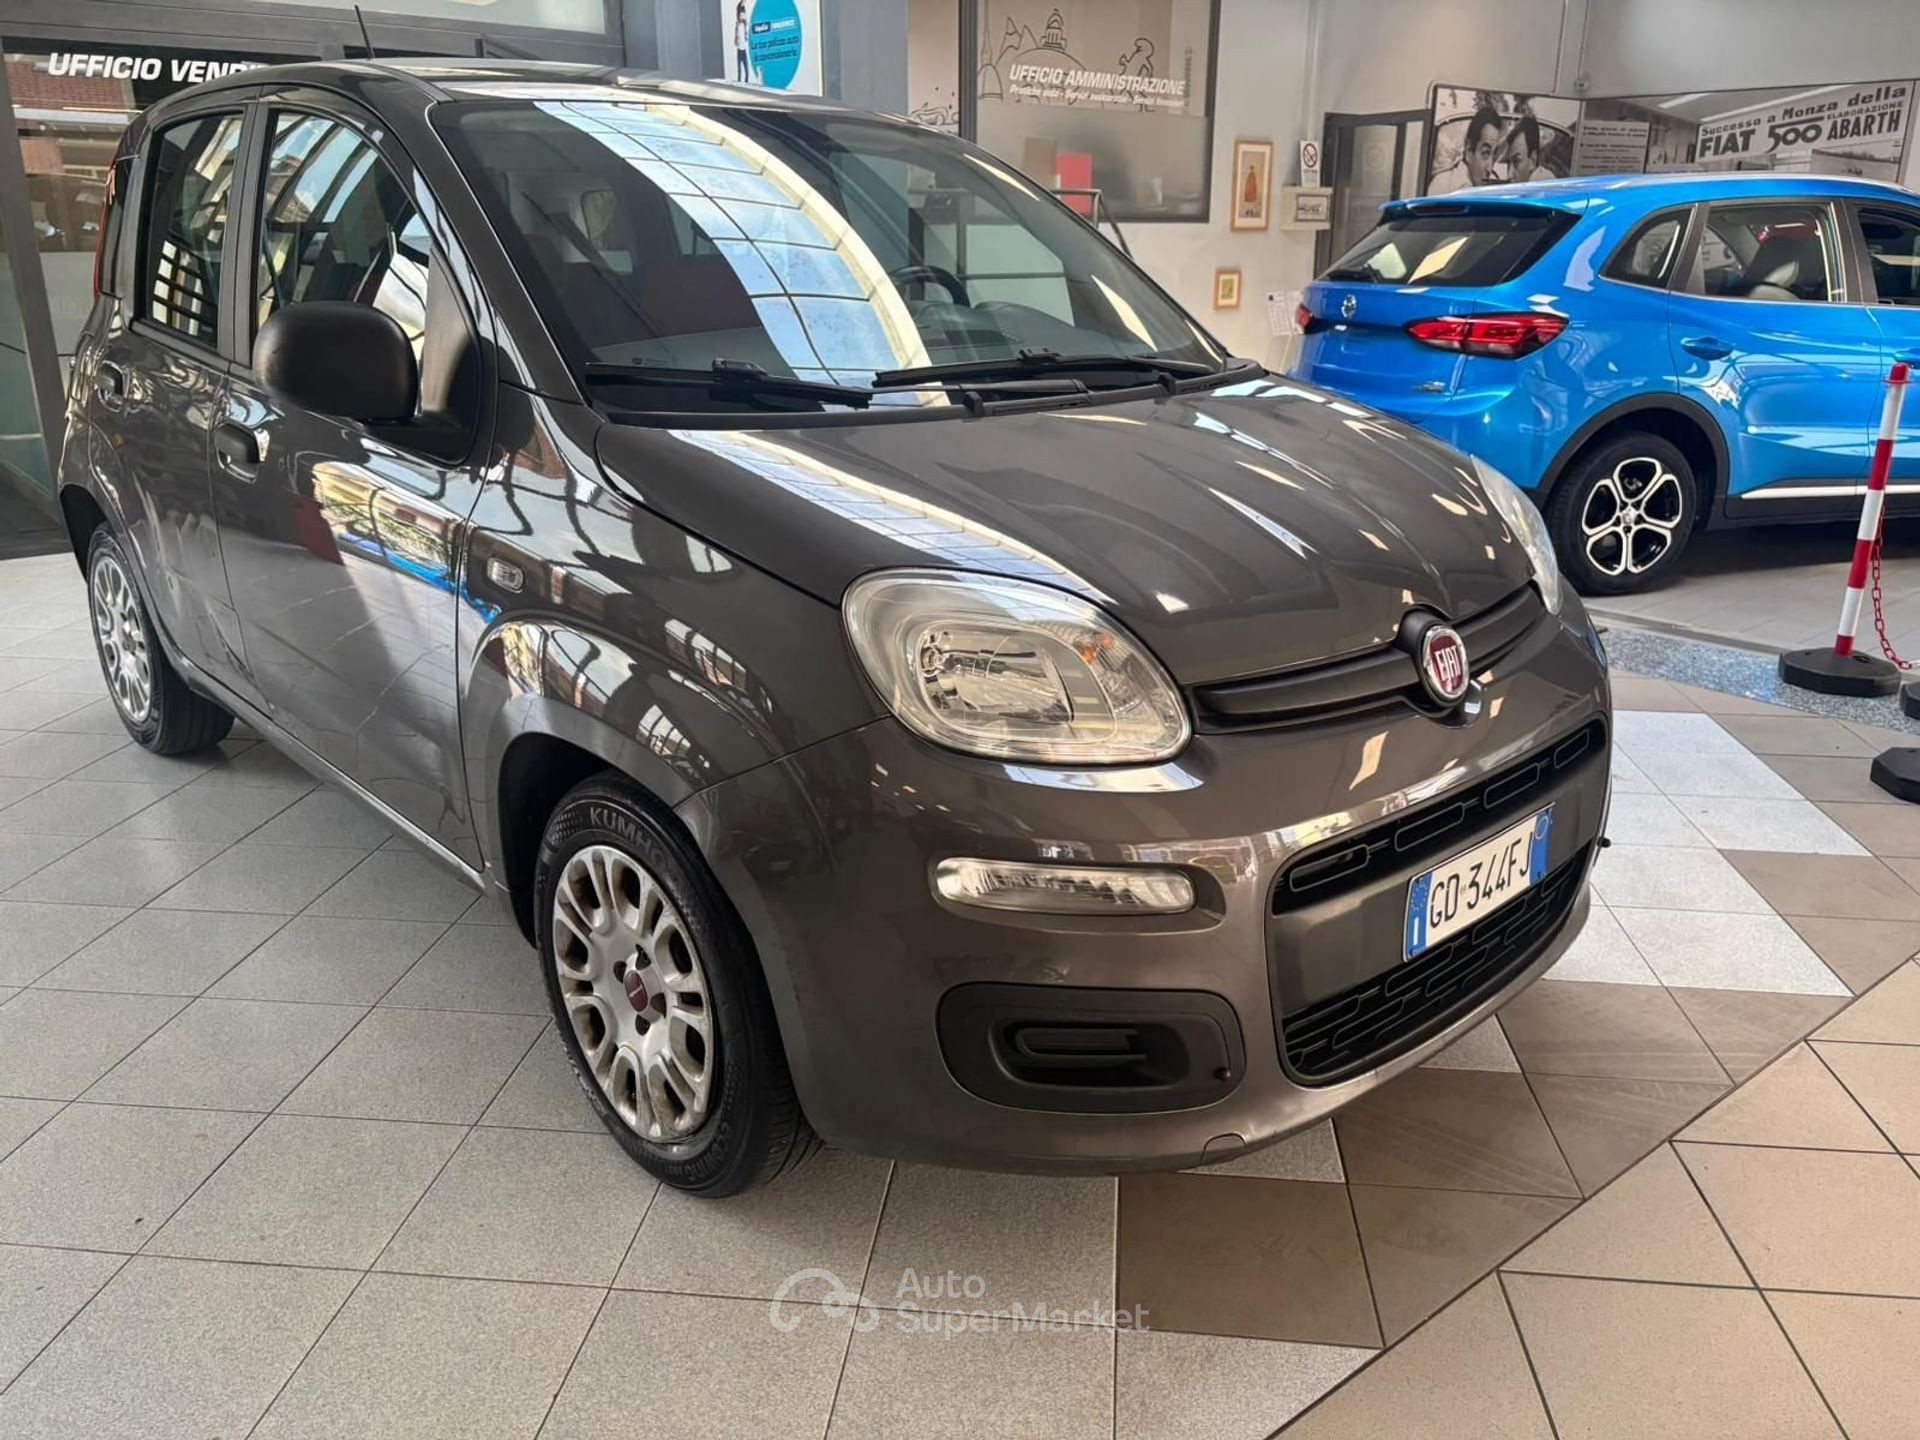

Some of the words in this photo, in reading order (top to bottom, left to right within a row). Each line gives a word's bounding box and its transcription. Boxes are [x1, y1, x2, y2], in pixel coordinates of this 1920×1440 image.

[48, 52, 163, 80] UFFICIO
[170, 59, 269, 83] VEN
[1009, 63, 1063, 84] UFFICIO
[1064, 69, 1186, 95] AMMINISTRAZIONE
[1701, 118, 1762, 137] Successo
[1767, 115, 1776, 123] a
[1782, 101, 1838, 121] Monza
[1847, 85, 1906, 107] della
[1826, 101, 1903, 120] ELABORAZIONE
[1827, 109, 1902, 141] ABARTH
[1699, 128, 1756, 158] FIAT
[1764, 116, 1824, 154] 500
[1434, 645, 1461, 681] FIAT
[589, 805, 667, 871] KUMHO
[1430, 873, 1460, 929] GD
